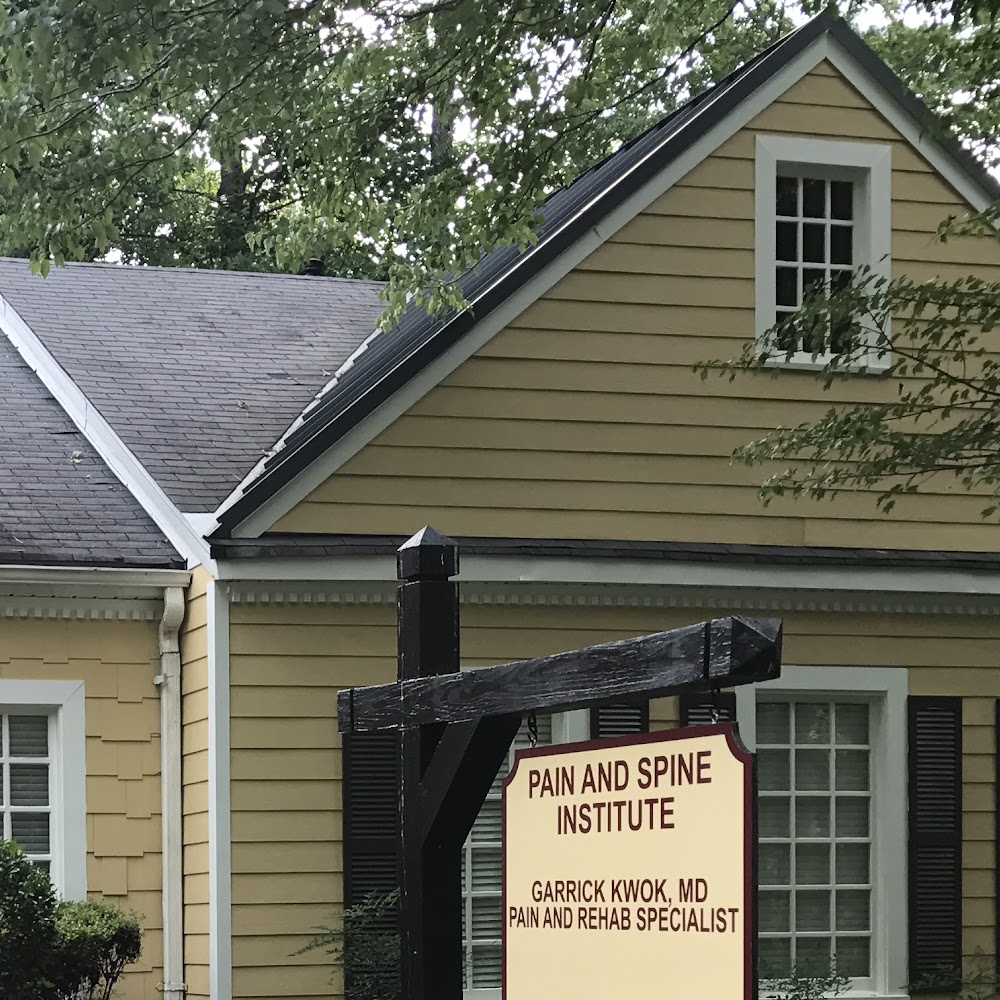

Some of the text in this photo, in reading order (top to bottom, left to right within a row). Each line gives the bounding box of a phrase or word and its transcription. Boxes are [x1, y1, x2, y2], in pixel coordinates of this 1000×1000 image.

[529, 750, 712, 798] PAIN AND SPINE
[557, 797, 675, 835] INSTITUTE
[531, 878, 708, 908] GARRICK KWOK, MD
[509, 906, 740, 934] PAIN AND REHAB SPECIALIST
